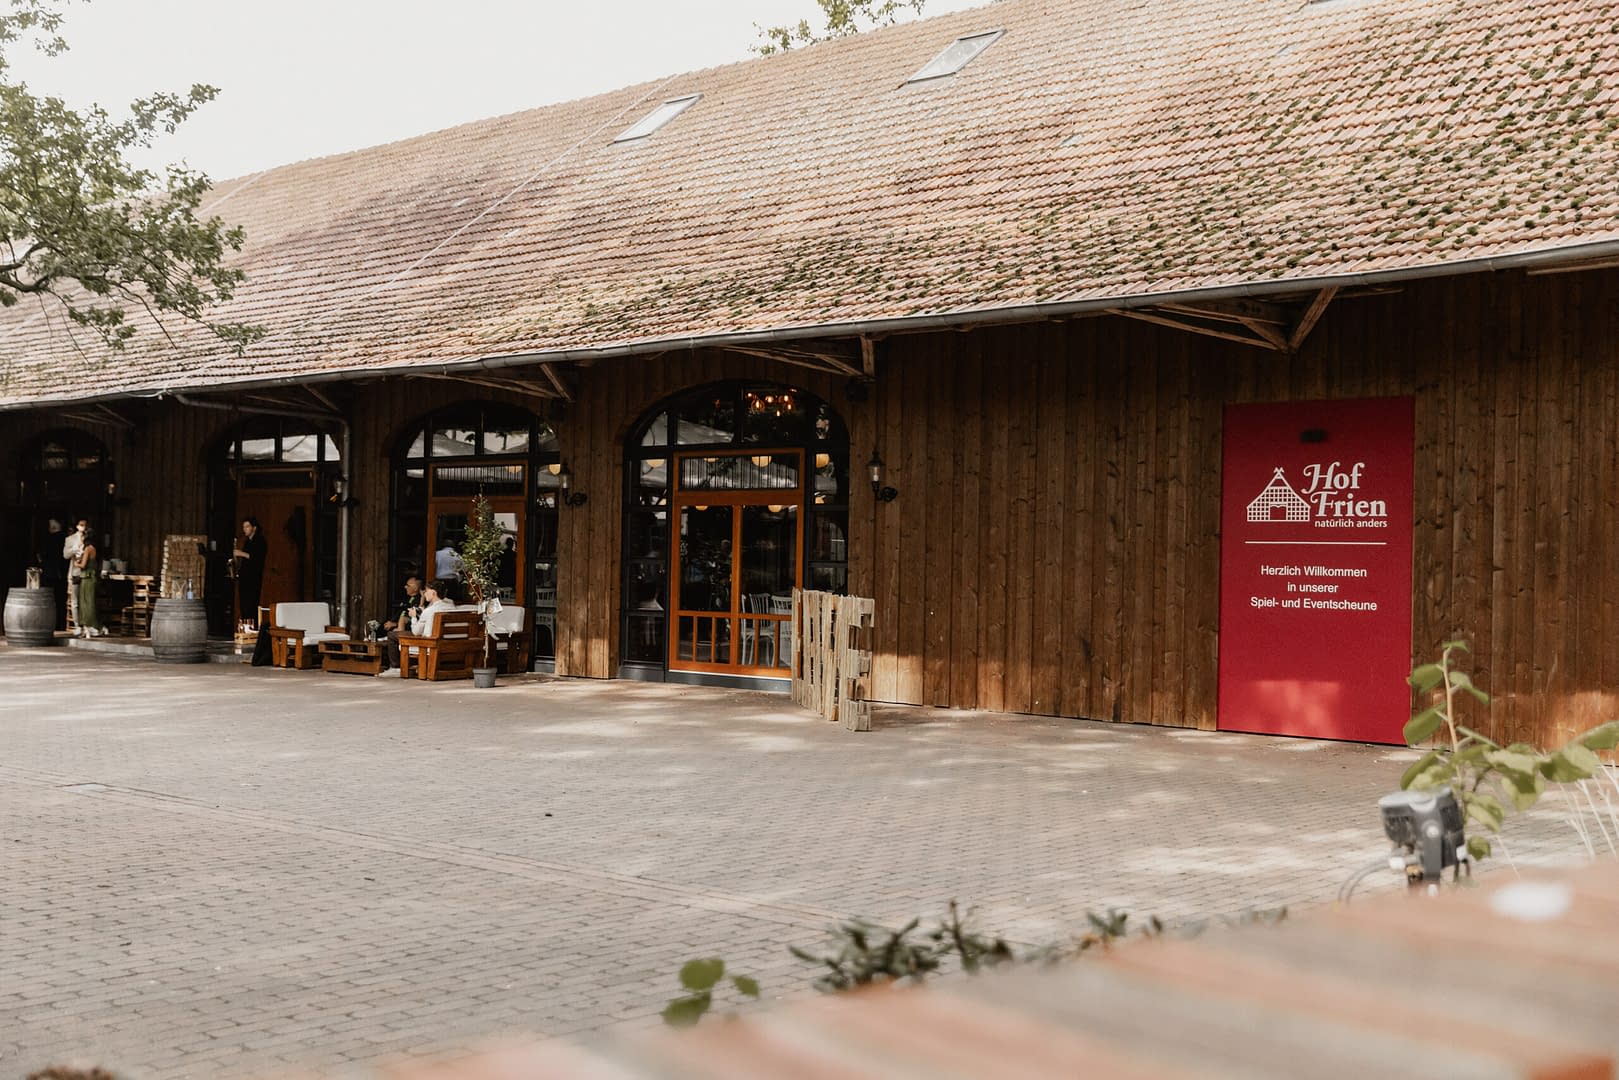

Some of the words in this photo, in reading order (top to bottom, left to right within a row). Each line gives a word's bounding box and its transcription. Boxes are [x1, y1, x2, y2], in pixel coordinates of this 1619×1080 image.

[1301, 461, 1365, 494] Hof
[1310, 490, 1388, 517] Frien
[1314, 518, 1354, 528] natürlich
[1356, 518, 1388, 528] anders
[1260, 565, 1301, 576] Herzlich
[1303, 566, 1367, 578] Willkommen
[1287, 582, 1297, 593] in
[1299, 583, 1339, 593] unserer
[1250, 596, 1279, 609] Spiel-
[1281, 597, 1301, 608] und
[1303, 598, 1377, 611] Eventscheune
